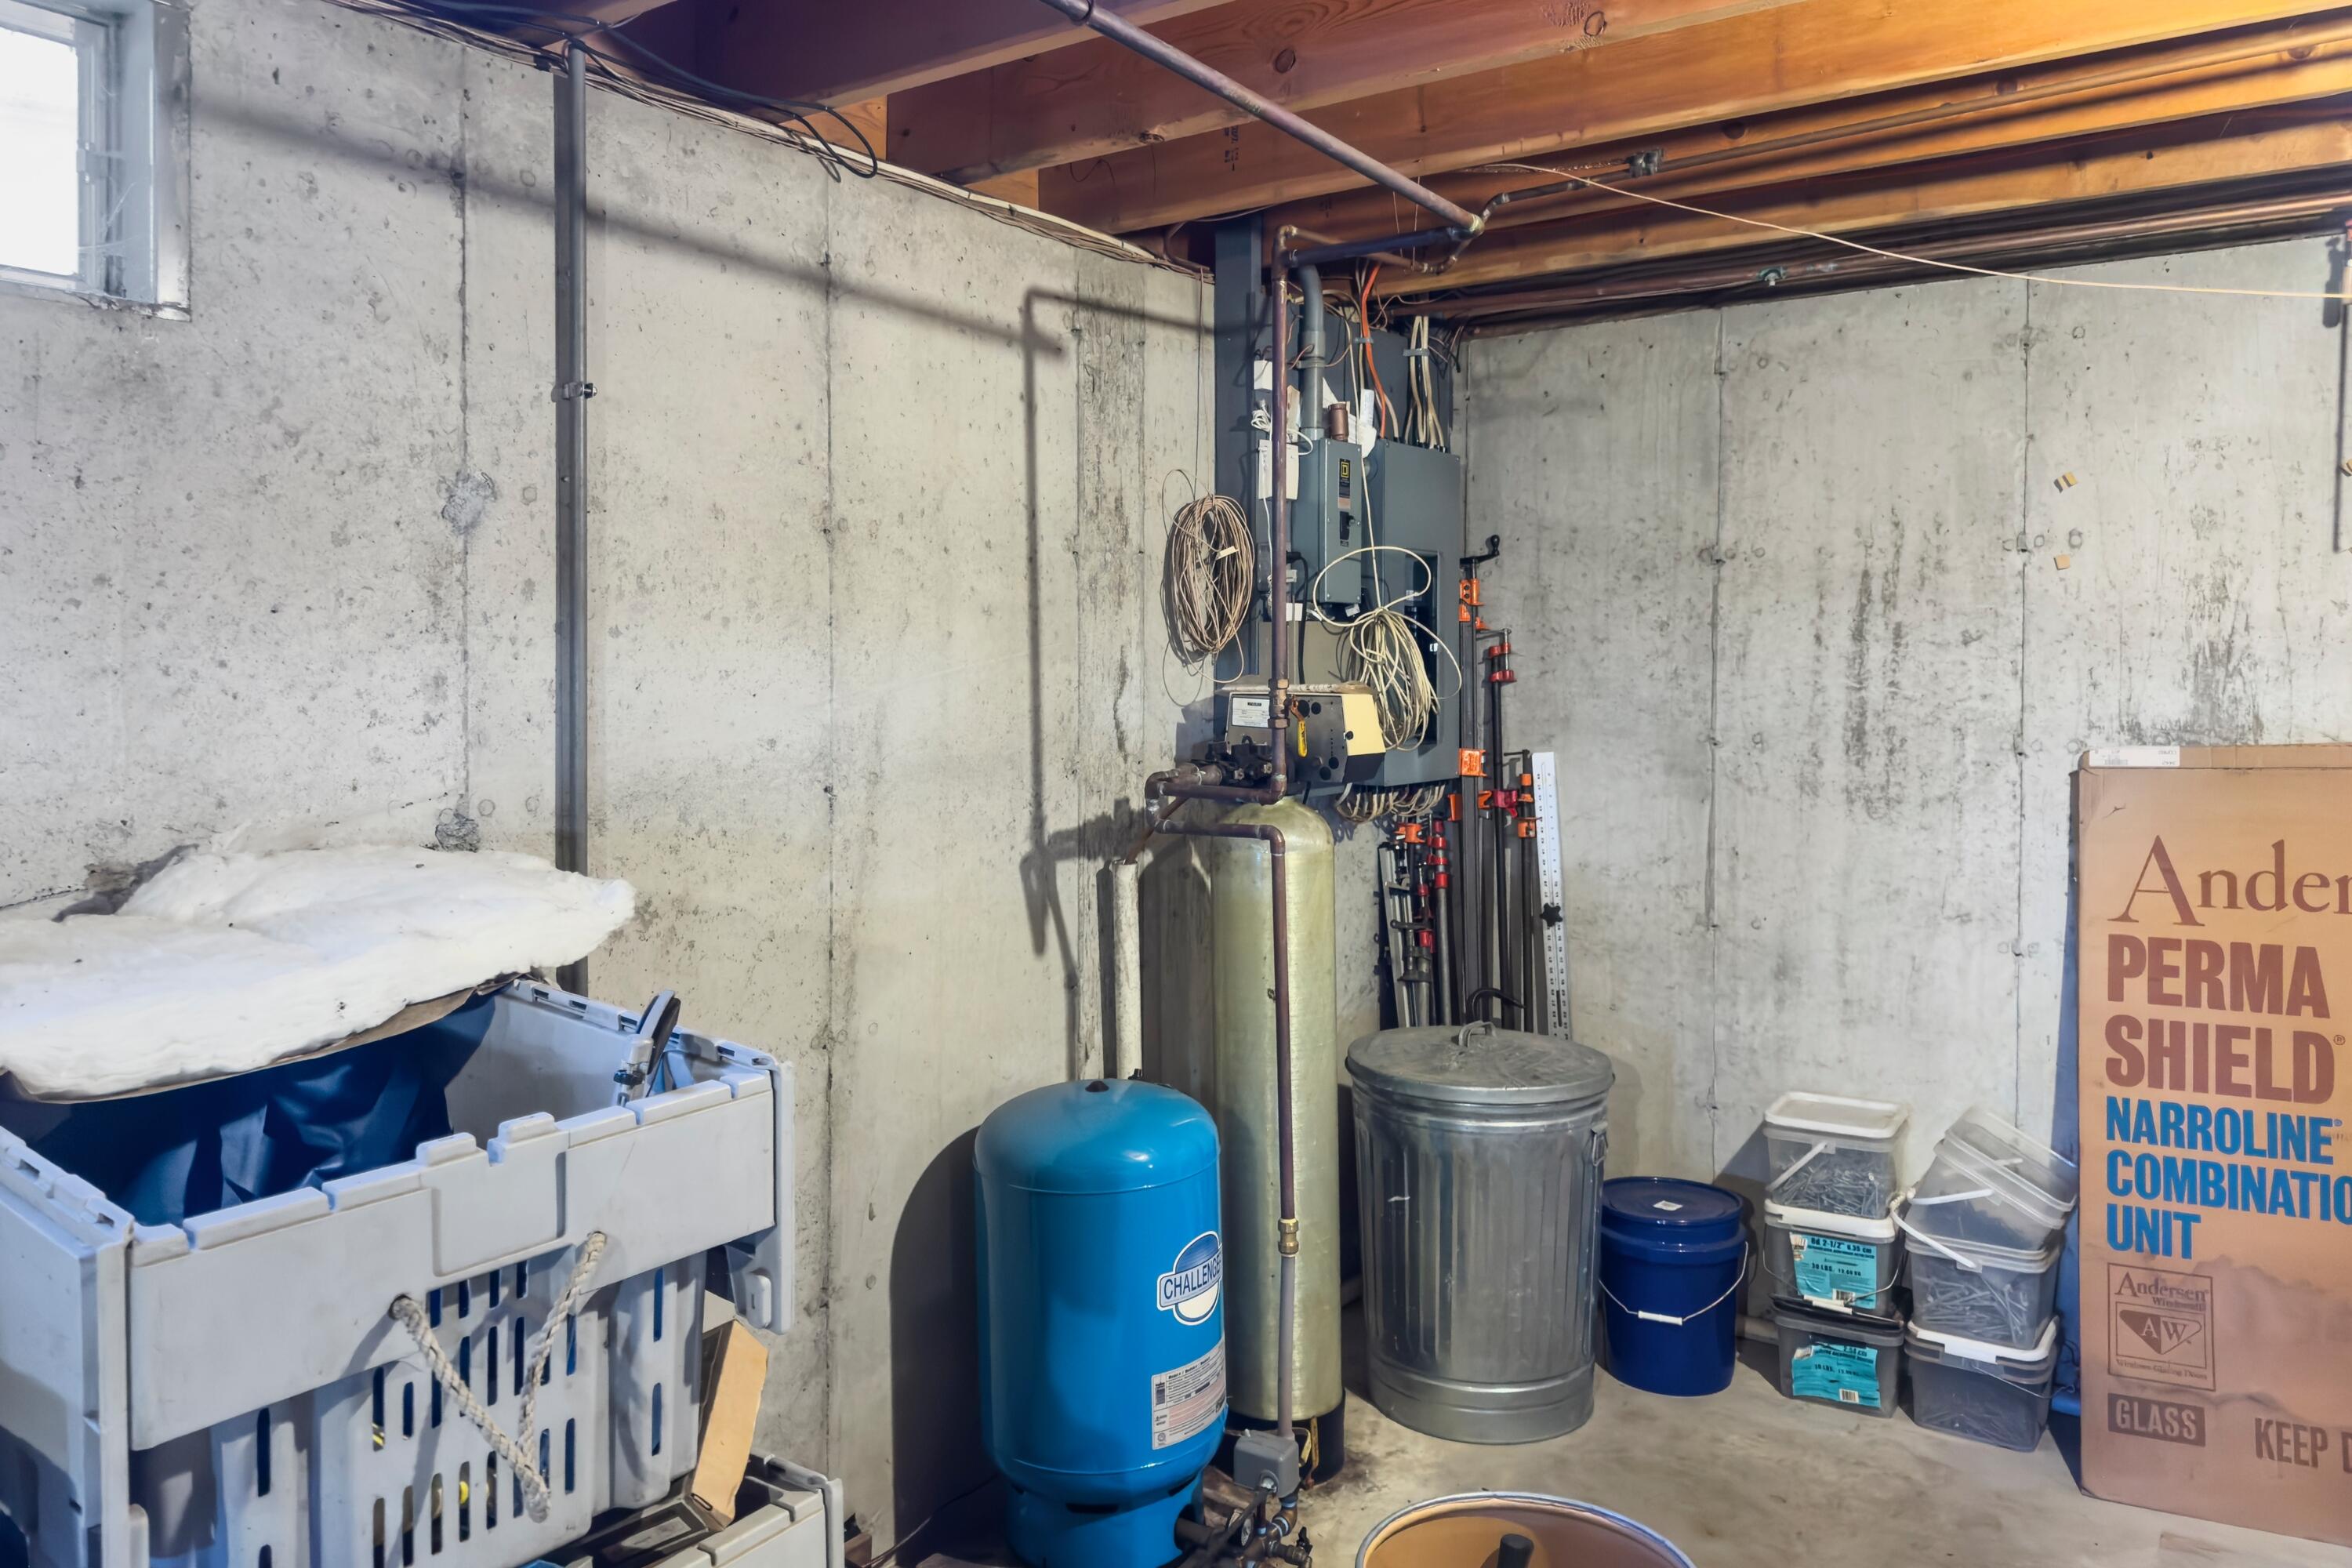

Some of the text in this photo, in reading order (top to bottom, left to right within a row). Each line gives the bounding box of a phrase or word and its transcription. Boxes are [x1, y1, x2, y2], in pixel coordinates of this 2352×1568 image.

[2107, 933, 2331, 1018] PERMA
[2107, 1203, 2201, 1259] UNIT
[1164, 1254, 1221, 1300] CHALLENGE
[2114, 1271, 2206, 1302] Andersen
[2115, 1399, 2196, 1440] GLASS
[2255, 1417, 2328, 1468] KEEP
